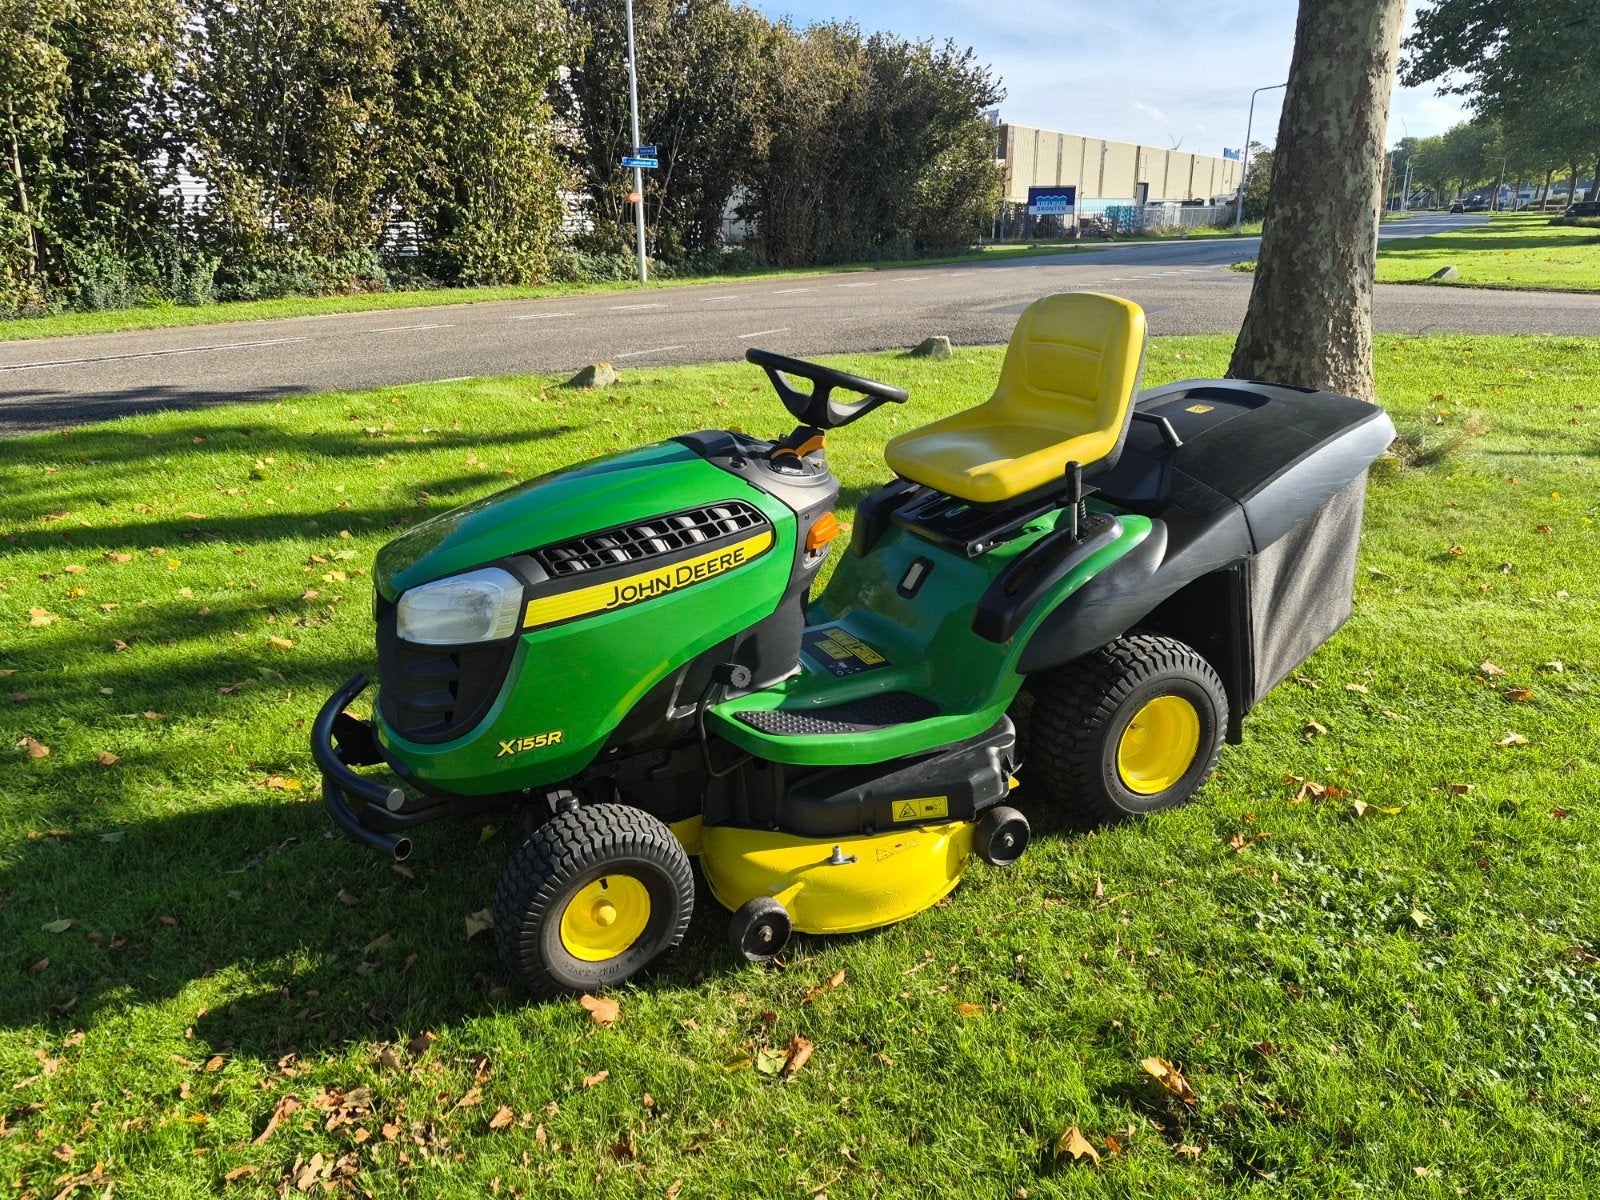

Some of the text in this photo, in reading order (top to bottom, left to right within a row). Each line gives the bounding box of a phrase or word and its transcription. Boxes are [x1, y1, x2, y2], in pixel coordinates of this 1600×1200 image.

[607, 547, 745, 607] JOHN DEERE
[496, 730, 562, 757] X155R
